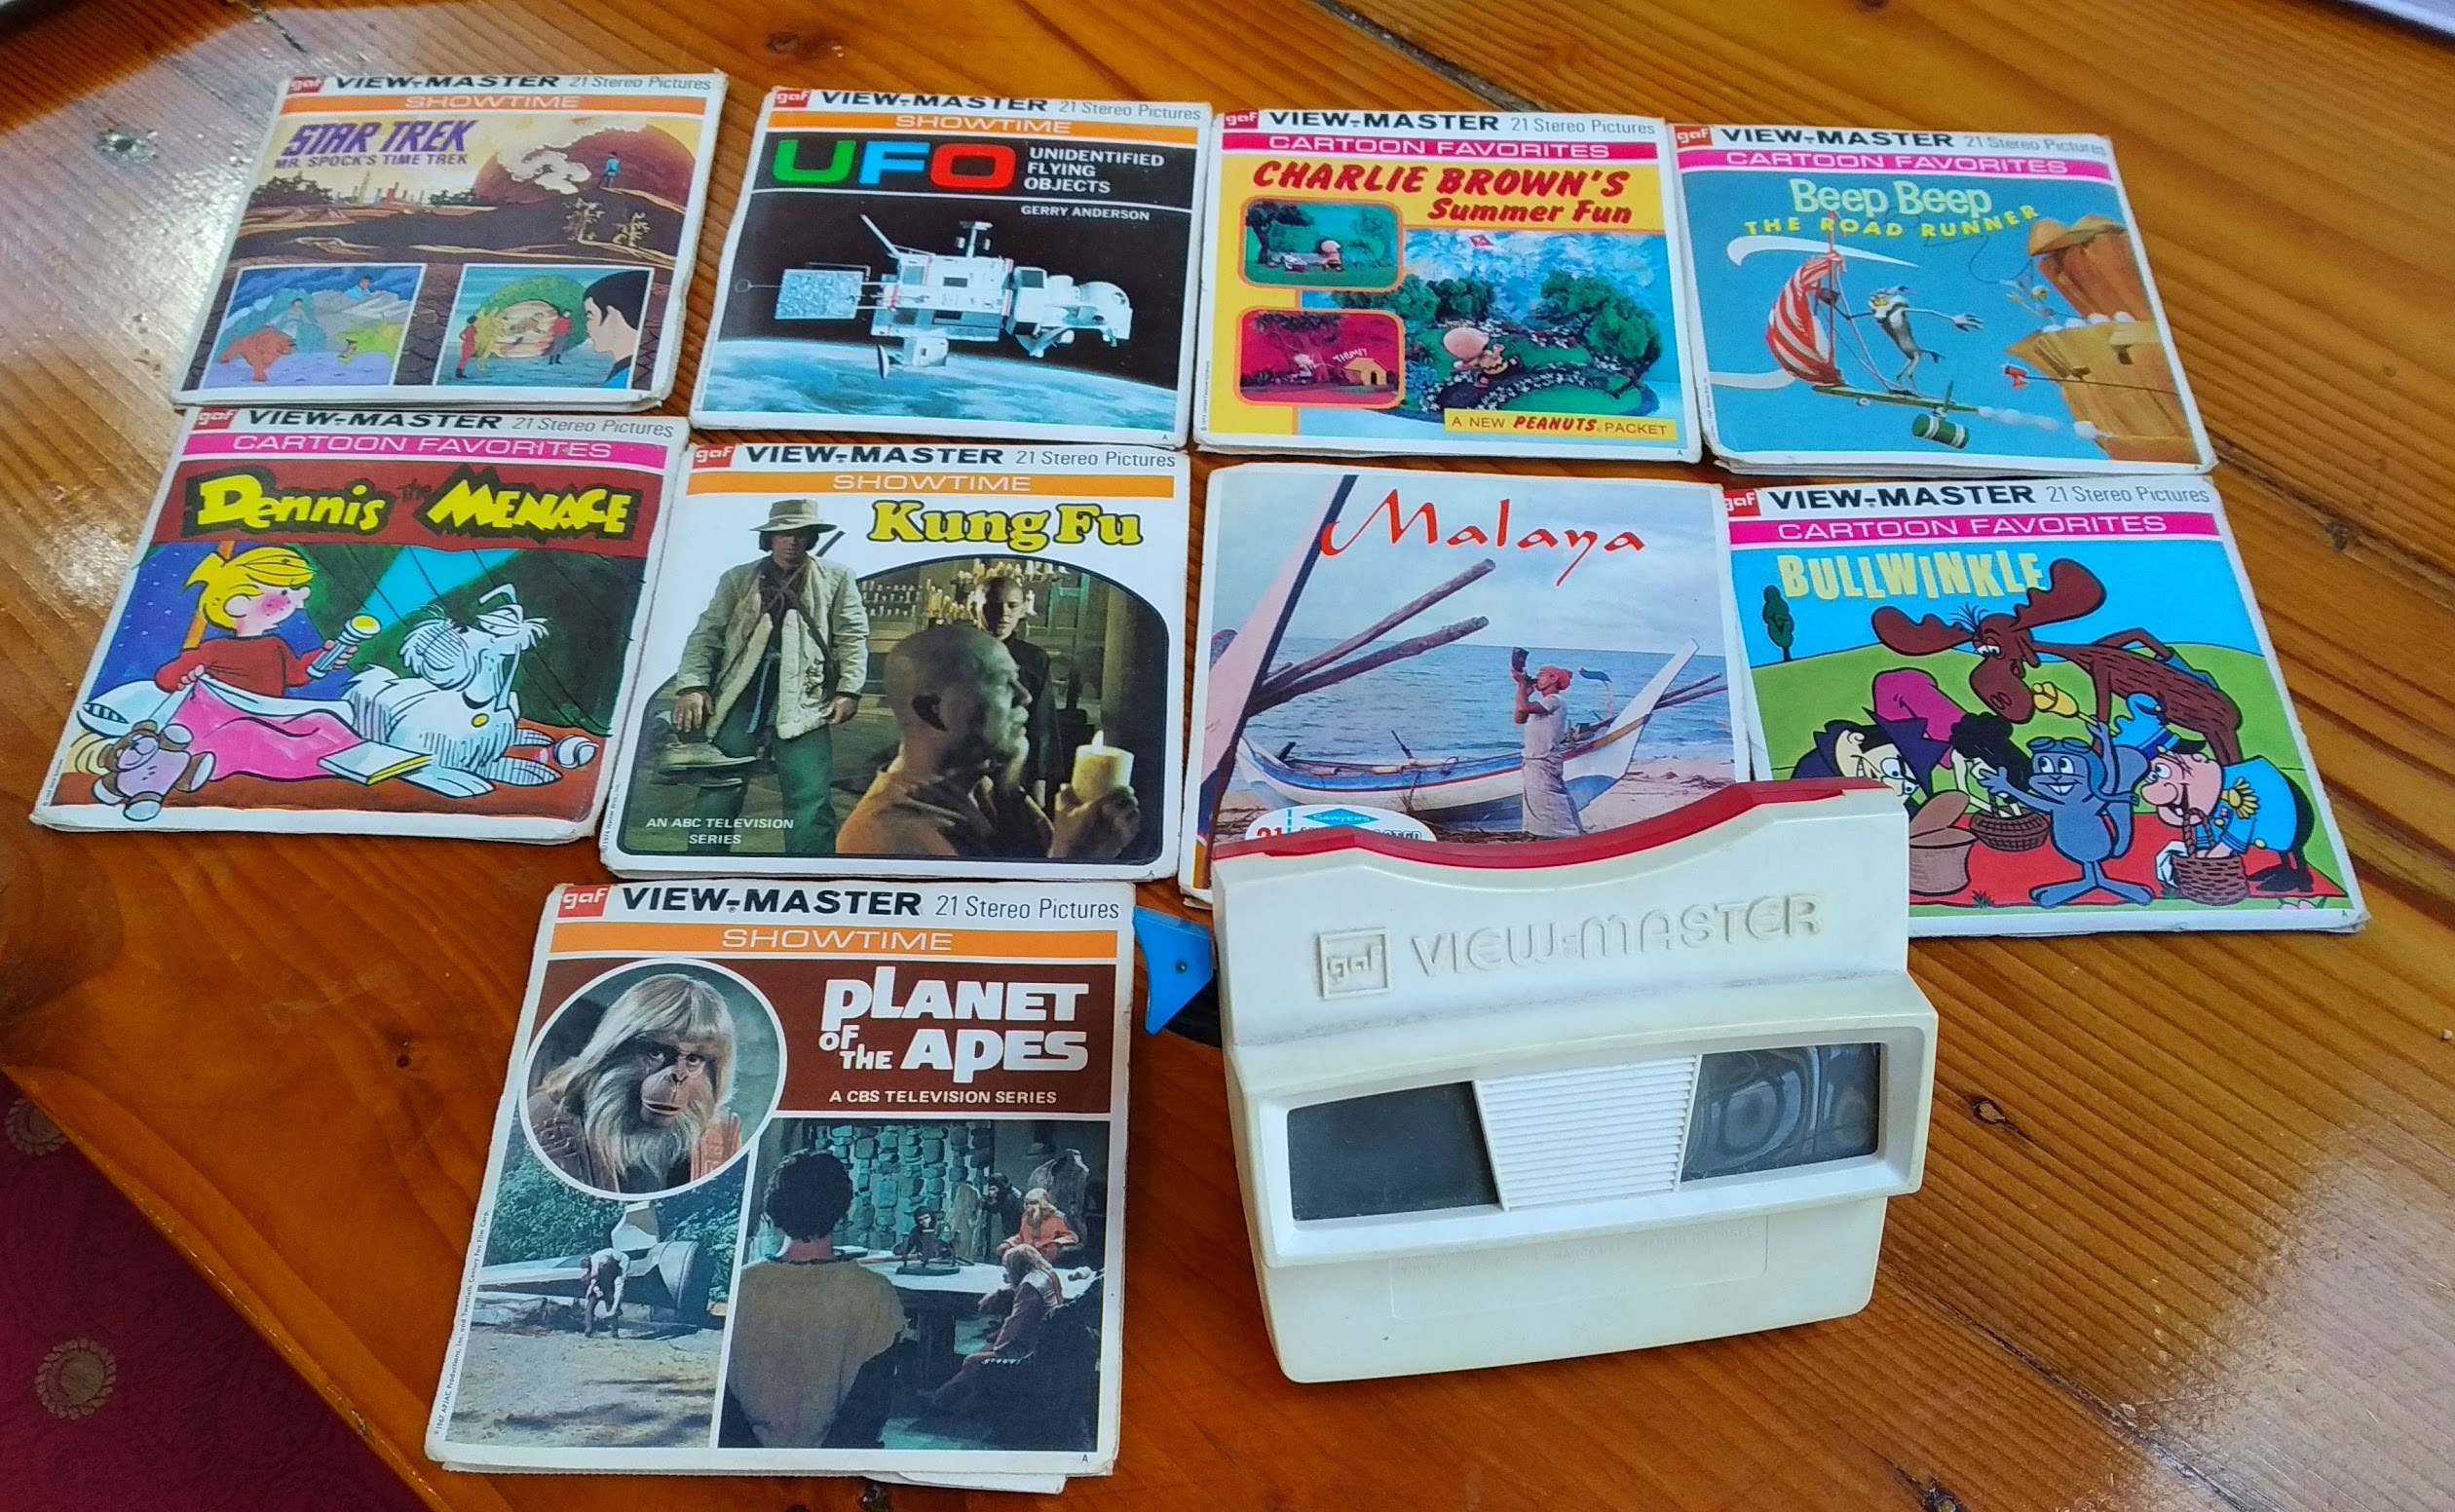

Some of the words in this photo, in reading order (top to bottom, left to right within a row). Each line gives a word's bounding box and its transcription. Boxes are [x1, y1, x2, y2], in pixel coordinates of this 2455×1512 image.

[291, 78, 322, 92] gaf
[336, 75, 560, 89] VIEW-MASTER
[569, 77, 586, 88] 21
[592, 77, 642, 89] Stereo
[648, 77, 711, 91] Pictures
[405, 95, 580, 109] SHOWTIME
[776, 92, 809, 104] gaf
[822, 92, 1047, 112] VIEW-MASTER
[1059, 102, 1076, 113] 21
[1082, 102, 1132, 116] Stereo
[1139, 104, 1201, 120] Pictures
[895, 115, 1071, 133] SHOWTIME
[1225, 111, 1258, 127] gaf
[1269, 112, 1499, 131] VIEW-MASTER
[1511, 118, 1528, 132] 21
[1534, 119, 1585, 133] Stereo
[1592, 120, 1655, 134] Pictures
[281, 123, 382, 157] STAR
[379, 120, 479, 152] TREK
[1269, 135, 1425, 154] CARTOON
[1438, 142, 1609, 159] FAVORITES
[1677, 128, 1709, 144] gaf
[1721, 129, 1954, 147] VIEW-MASTER
[1967, 135, 1983, 147] 21
[1988, 136, 2040, 151] Stereo
[2046, 138, 2107, 156] Pictures
[308, 154, 377, 168] SPOCK'S
[383, 154, 420, 165] TIME
[428, 153, 468, 165] TREK
[773, 139, 1016, 190] UFO
[1030, 147, 1164, 168] UNIDENTIFIED
[1726, 152, 1885, 168] CARTOON
[1896, 156, 2067, 173] FAVORITES
[1028, 162, 1096, 177] FLYING
[1253, 161, 1428, 193] CHARLIE
[1436, 168, 1631, 198] BROWN'S
[1024, 177, 1111, 194] OBJECTS
[1790, 178, 1889, 218] Beep
[1894, 180, 1992, 219] Beep
[1021, 205, 1069, 216] GERRY
[1072, 207, 1151, 221] ANDERSON
[1427, 198, 1565, 222] Summer
[1571, 200, 1632, 223] Fun
[1745, 217, 1800, 236] THE
[1820, 217, 1904, 237] ROAD
[1921, 205, 2039, 238] RUNNER
[198, 409, 234, 425] gaf
[249, 410, 503, 429] VIEW-MASTER
[512, 417, 533, 429] 21
[538, 417, 595, 432] Stereo
[601, 420, 674, 437] Pictures
[1452, 416, 1462, 427] A
[1470, 417, 1505, 429] NEW
[1512, 416, 1598, 432] PEANUTS
[1605, 422, 1668, 435] PACKET
[233, 435, 407, 452] CARTOON
[418, 438, 612, 458] FAVORITES
[695, 445, 734, 463] gaf
[746, 446, 1003, 464] VIEW-MASTER
[1016, 450, 1035, 464] 21
[1040, 450, 1098, 466] Stereo
[1106, 451, 1176, 468] Pictures
[833, 475, 1032, 492] SHOWTIME
[197, 473, 386, 531] Dennis
[426, 479, 632, 533] MENACE
[1768, 485, 2037, 510] VIEW-MASTER
[2047, 486, 2069, 503] 21
[2074, 486, 2133, 502] Stereo
[2136, 486, 2210, 503] Pictures
[867, 499, 1050, 553] Kung
[1053, 504, 1144, 546] Fu
[1778, 520, 1958, 541] CARTOON
[1971, 515, 2168, 535] FAVORITES
[1320, 488, 1646, 587] Malaya
[1777, 550, 2044, 600] BULLWINKLE
[646, 818, 668, 829] AN
[670, 818, 701, 829] ABC
[705, 818, 794, 829] TELEVISION
[689, 834, 742, 845] SERIES
[562, 888, 608, 909] gaf
[623, 887, 922, 915] VIEW-MASTER
[935, 895, 958, 916] 21
[965, 895, 1030, 919] Stereo
[1039, 897, 1119, 920] Pictures
[722, 928, 954, 952] SHOWTIME
[1412, 893, 1824, 976] VIEW-MASTER
[818, 1024, 860, 1051] OF
[839, 1043, 893, 1070] THE
[900, 1029, 1089, 1084] APES
[829, 1090, 843, 1103] A
[847, 1090, 880, 1104] CBS
[885, 1090, 991, 1104] TELEVISION
[995, 1090, 1057, 1104] SERIES
[1082, 1453, 1089, 1462] A
